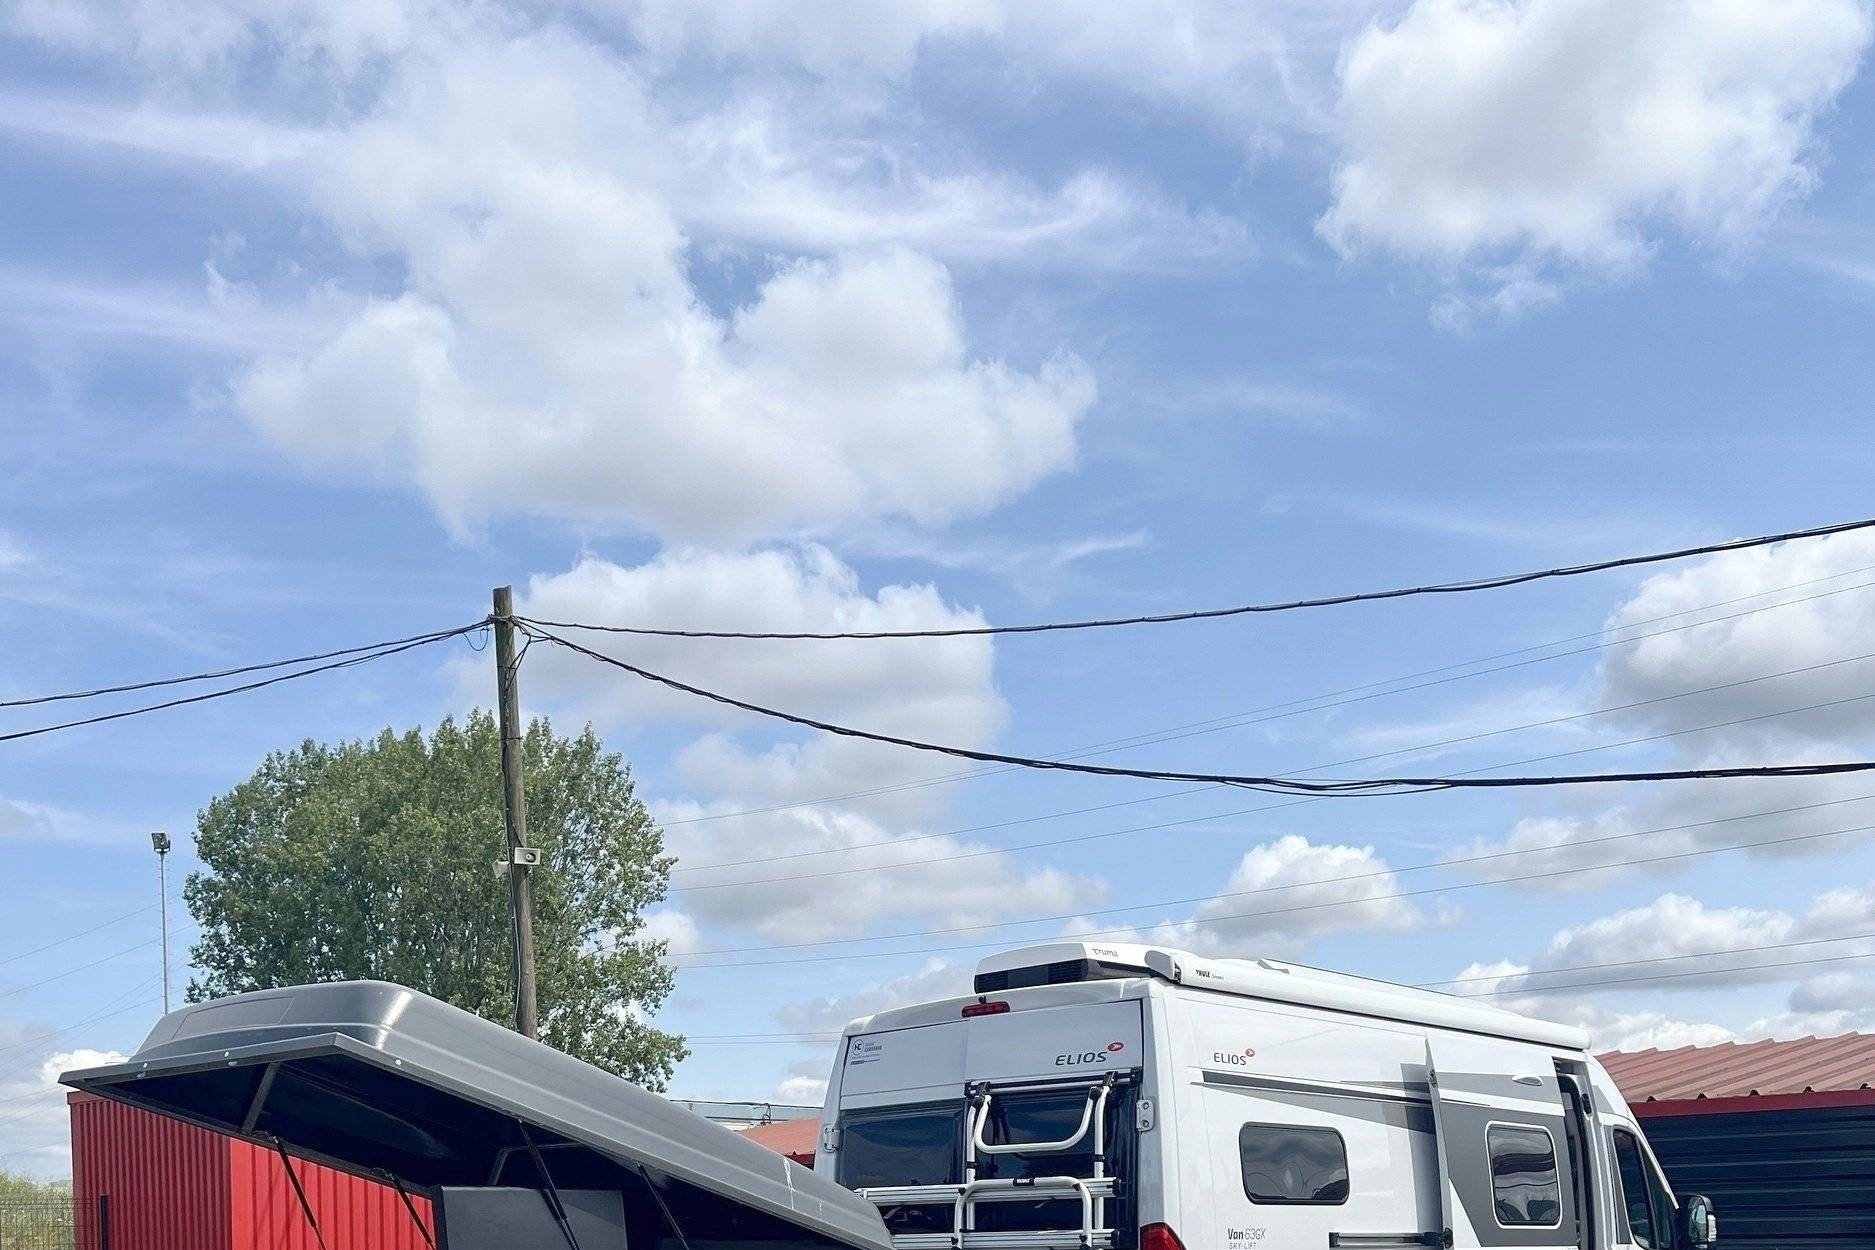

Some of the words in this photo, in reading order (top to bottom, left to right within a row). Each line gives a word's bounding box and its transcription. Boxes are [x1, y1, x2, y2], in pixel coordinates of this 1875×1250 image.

[1055, 1051, 1108, 1066] ELIOS
[1213, 1052, 1247, 1066] ELIOS
[1227, 1227, 1244, 1240] Van
